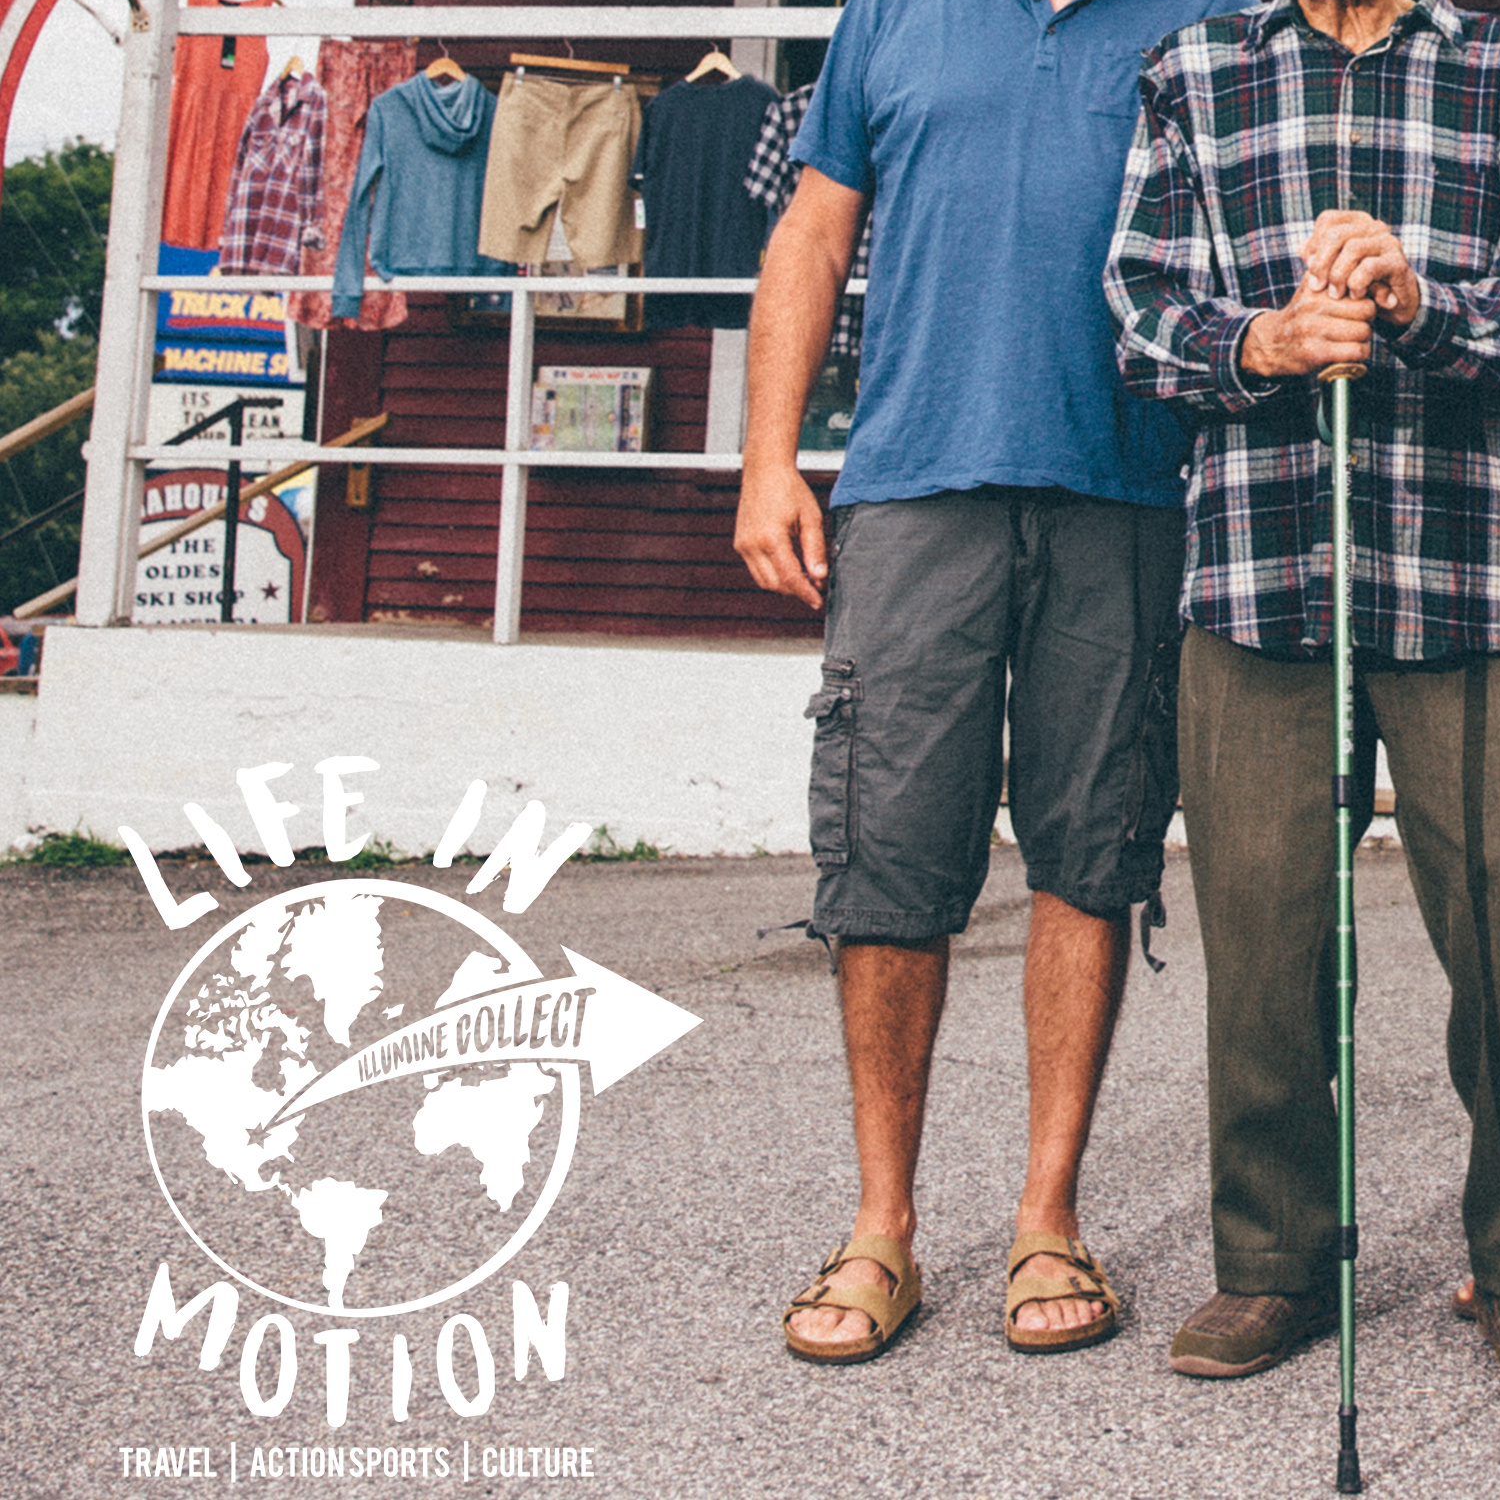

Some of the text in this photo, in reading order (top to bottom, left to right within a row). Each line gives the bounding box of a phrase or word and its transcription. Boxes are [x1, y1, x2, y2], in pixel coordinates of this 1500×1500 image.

[169, 291, 286, 321] TRUCK PA
[164, 347, 268, 375] MACHINE
[182, 392, 210, 407] ITS
[170, 538, 216, 555] THE
[145, 564, 222, 580] OLDES
[135, 591, 176, 607] SKI
